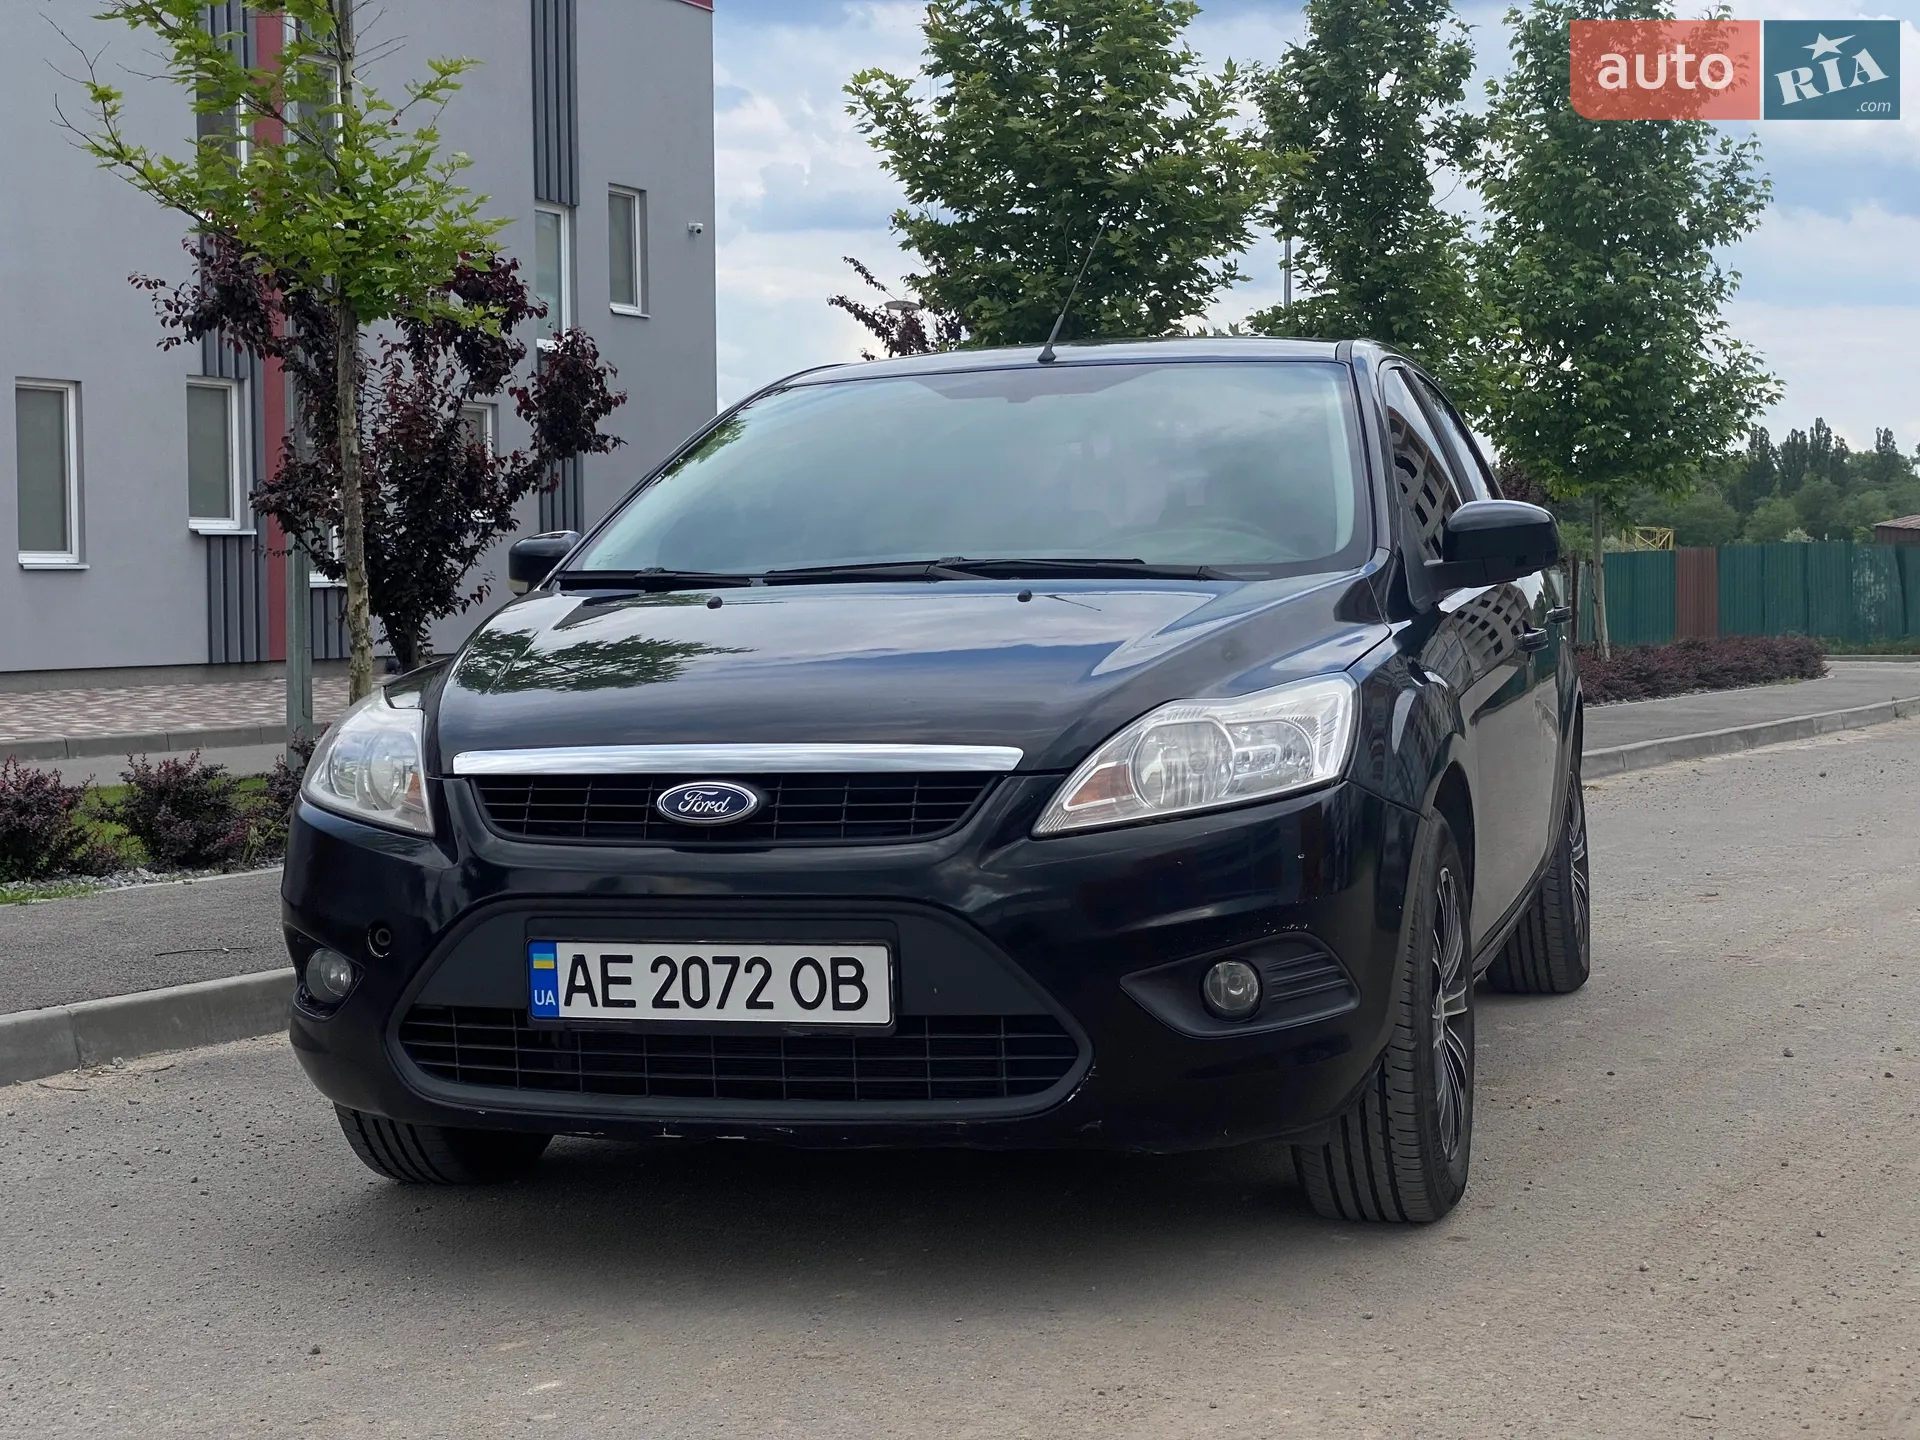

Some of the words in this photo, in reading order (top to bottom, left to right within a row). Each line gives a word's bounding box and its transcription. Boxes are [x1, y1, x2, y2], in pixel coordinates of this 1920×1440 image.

[678, 789, 732, 813] Ford
[563, 953, 637, 1009] AE
[649, 955, 775, 1010] 2072
[789, 956, 869, 1011] OB
[533, 989, 557, 1006] UA
